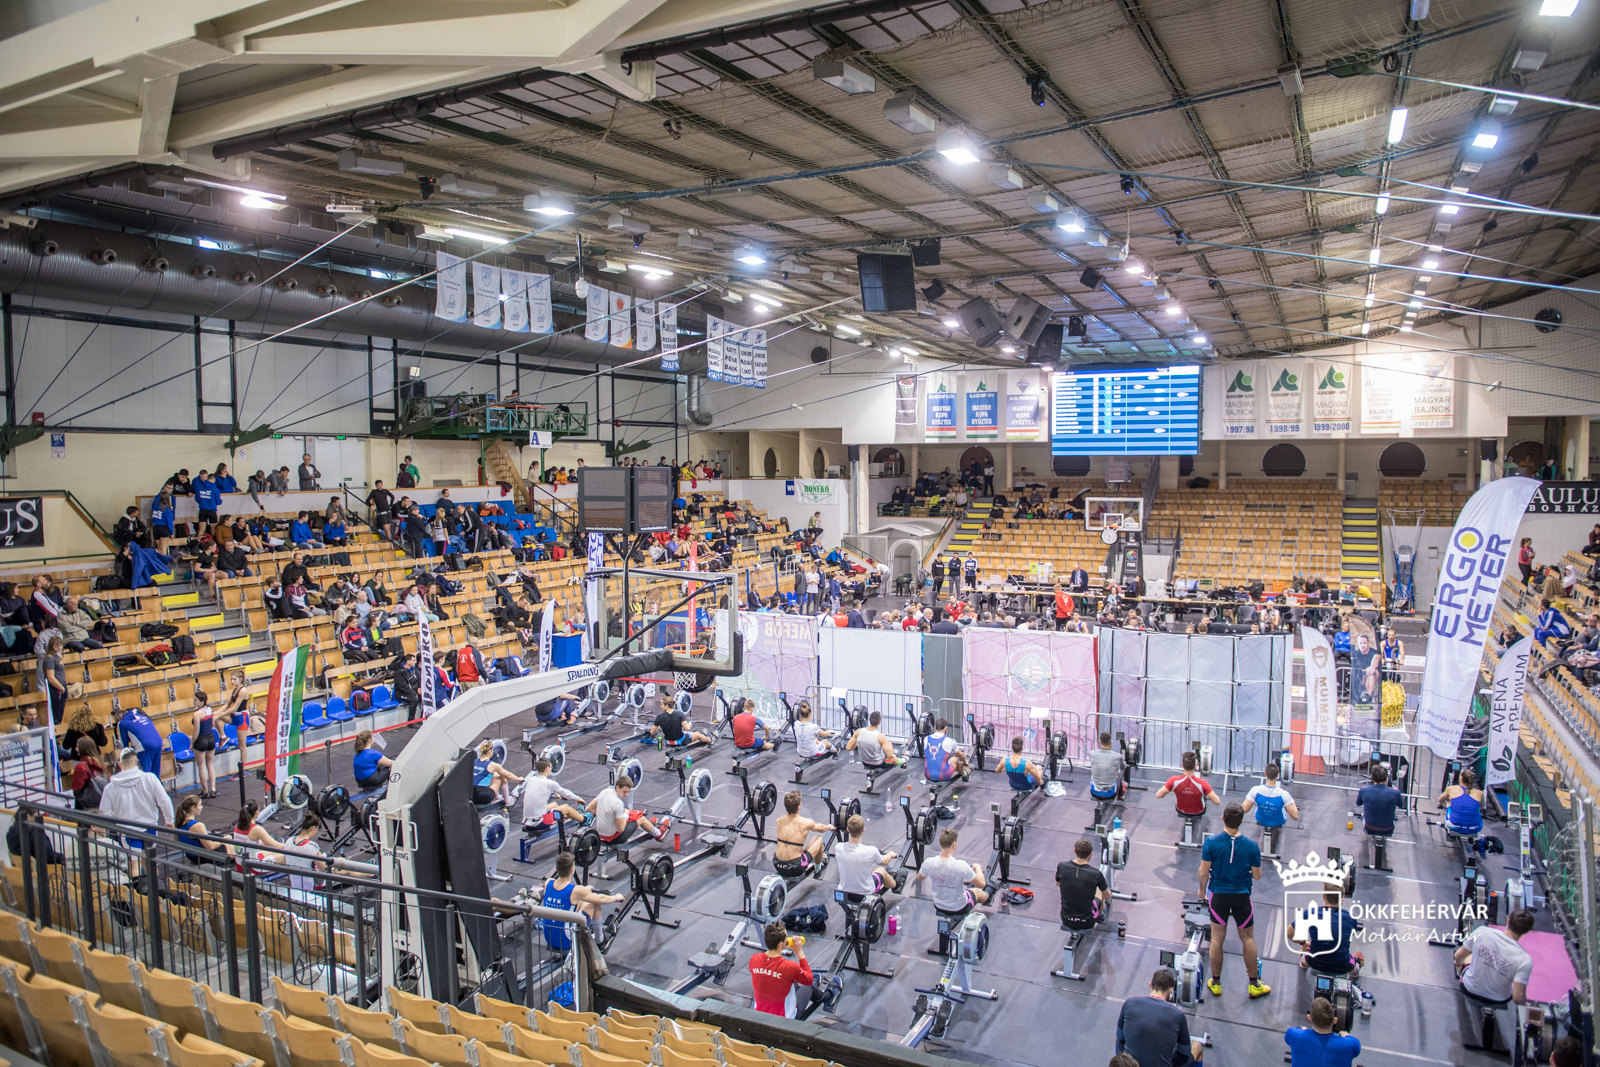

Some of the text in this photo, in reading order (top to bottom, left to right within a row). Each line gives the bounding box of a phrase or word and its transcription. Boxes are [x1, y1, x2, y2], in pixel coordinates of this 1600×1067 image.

[1224, 400, 1256, 408] MAGYAR
[1414, 396, 1451, 404] MAGYAR
[1269, 403, 1301, 411] MAGYAR
[1315, 401, 1349, 409] MAGYAR
[1414, 405, 1451, 414] BAJNOK
[1316, 409, 1348, 417] BAJNOK
[931, 418, 952, 426] GYŐZTES
[971, 417, 993, 425] GYŐZTES
[1011, 418, 1035, 426] GYŐZTES
[1226, 425, 1255, 434] 1997/98
[1270, 424, 1300, 433] 1998/99
[1314, 422, 1350, 431] 1999/2000
[53, 433, 64, 442] WC
[531, 432, 541, 445] A
[1529, 503, 1600, 513] BORHÁZ
[4, 535, 14, 546] Z
[1434, 526, 1484, 638] ERGO
[1459, 533, 1512, 647] METER
[567, 665, 599, 683] SPALDING
[1492, 677, 1510, 733] AVENA
[382, 848, 409, 861] SPADING
[547, 896, 562, 905] MTK
[752, 967, 783, 980] VASAS SC
